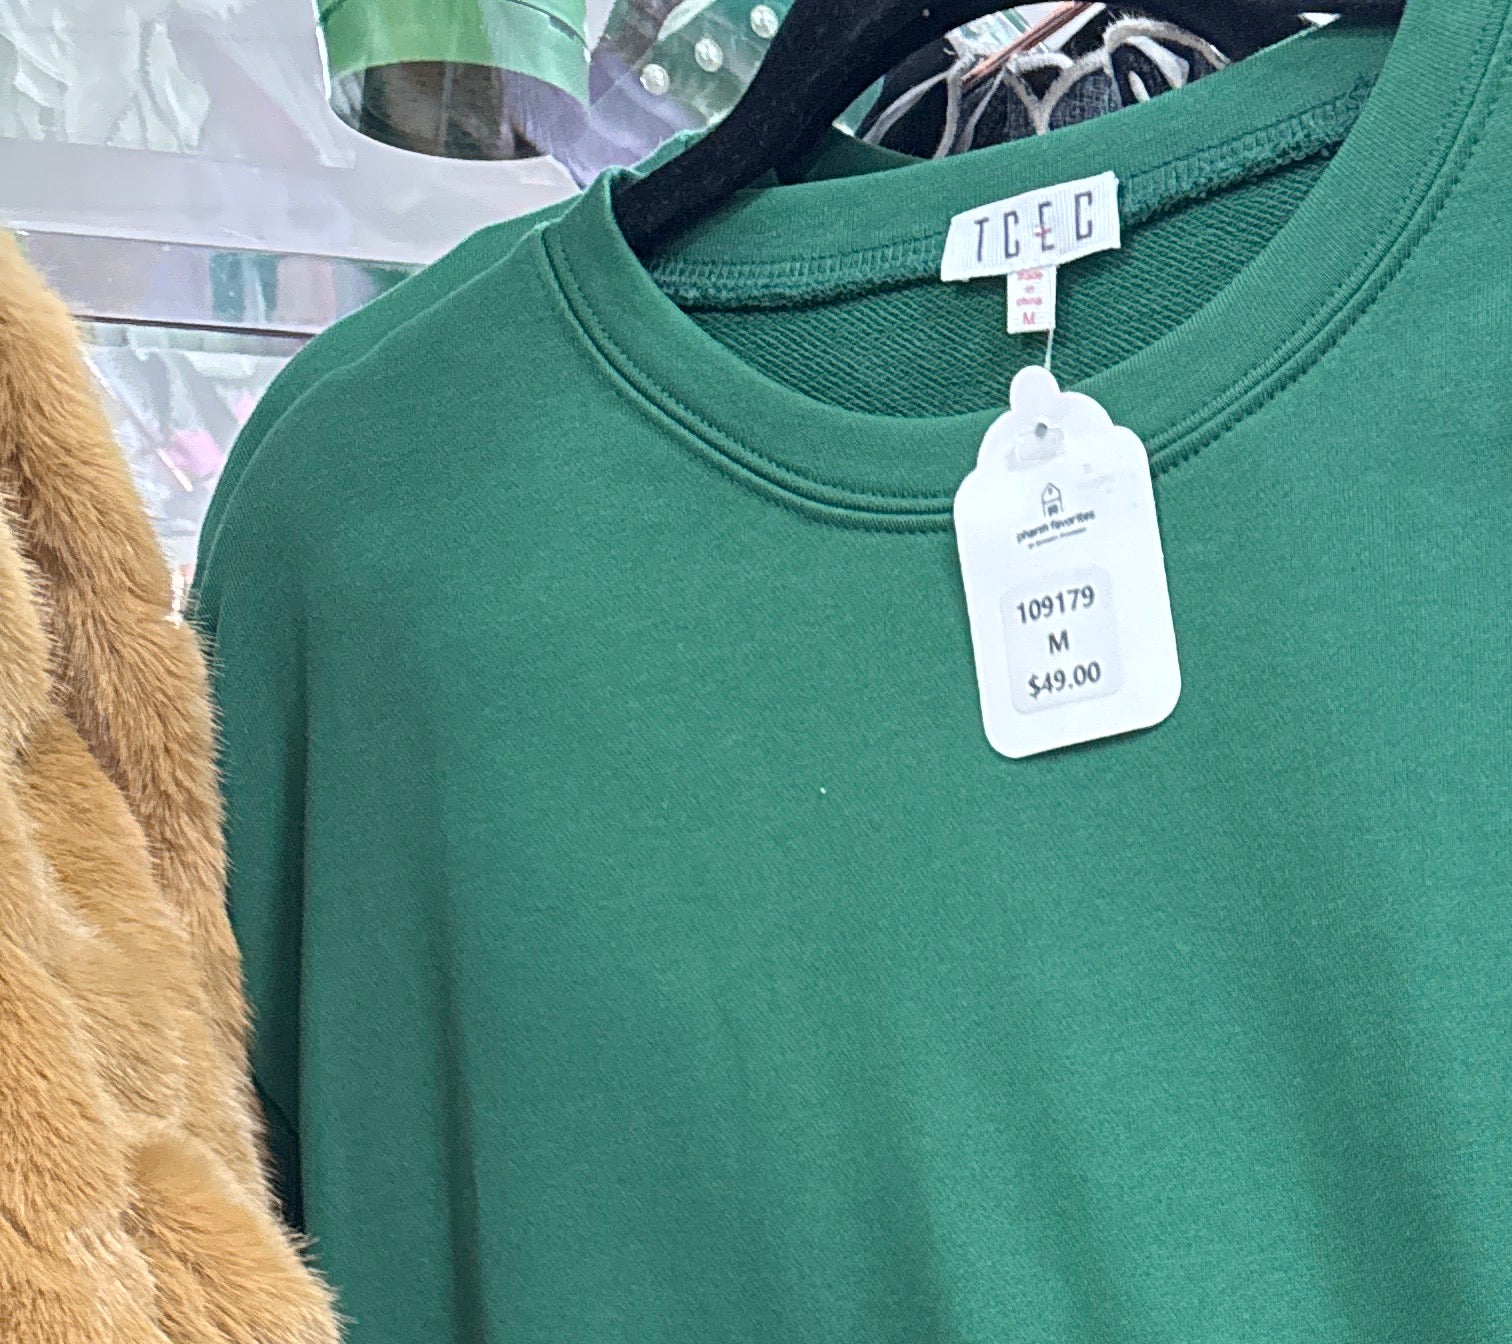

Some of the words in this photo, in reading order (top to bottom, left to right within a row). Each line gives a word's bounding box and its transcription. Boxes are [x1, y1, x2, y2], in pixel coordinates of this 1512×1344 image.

[1022, 311, 1036, 325] M
[1017, 583, 1095, 624] 109179
[1048, 629, 1070, 655] M
[1027, 660, 1102, 701] $49.00
